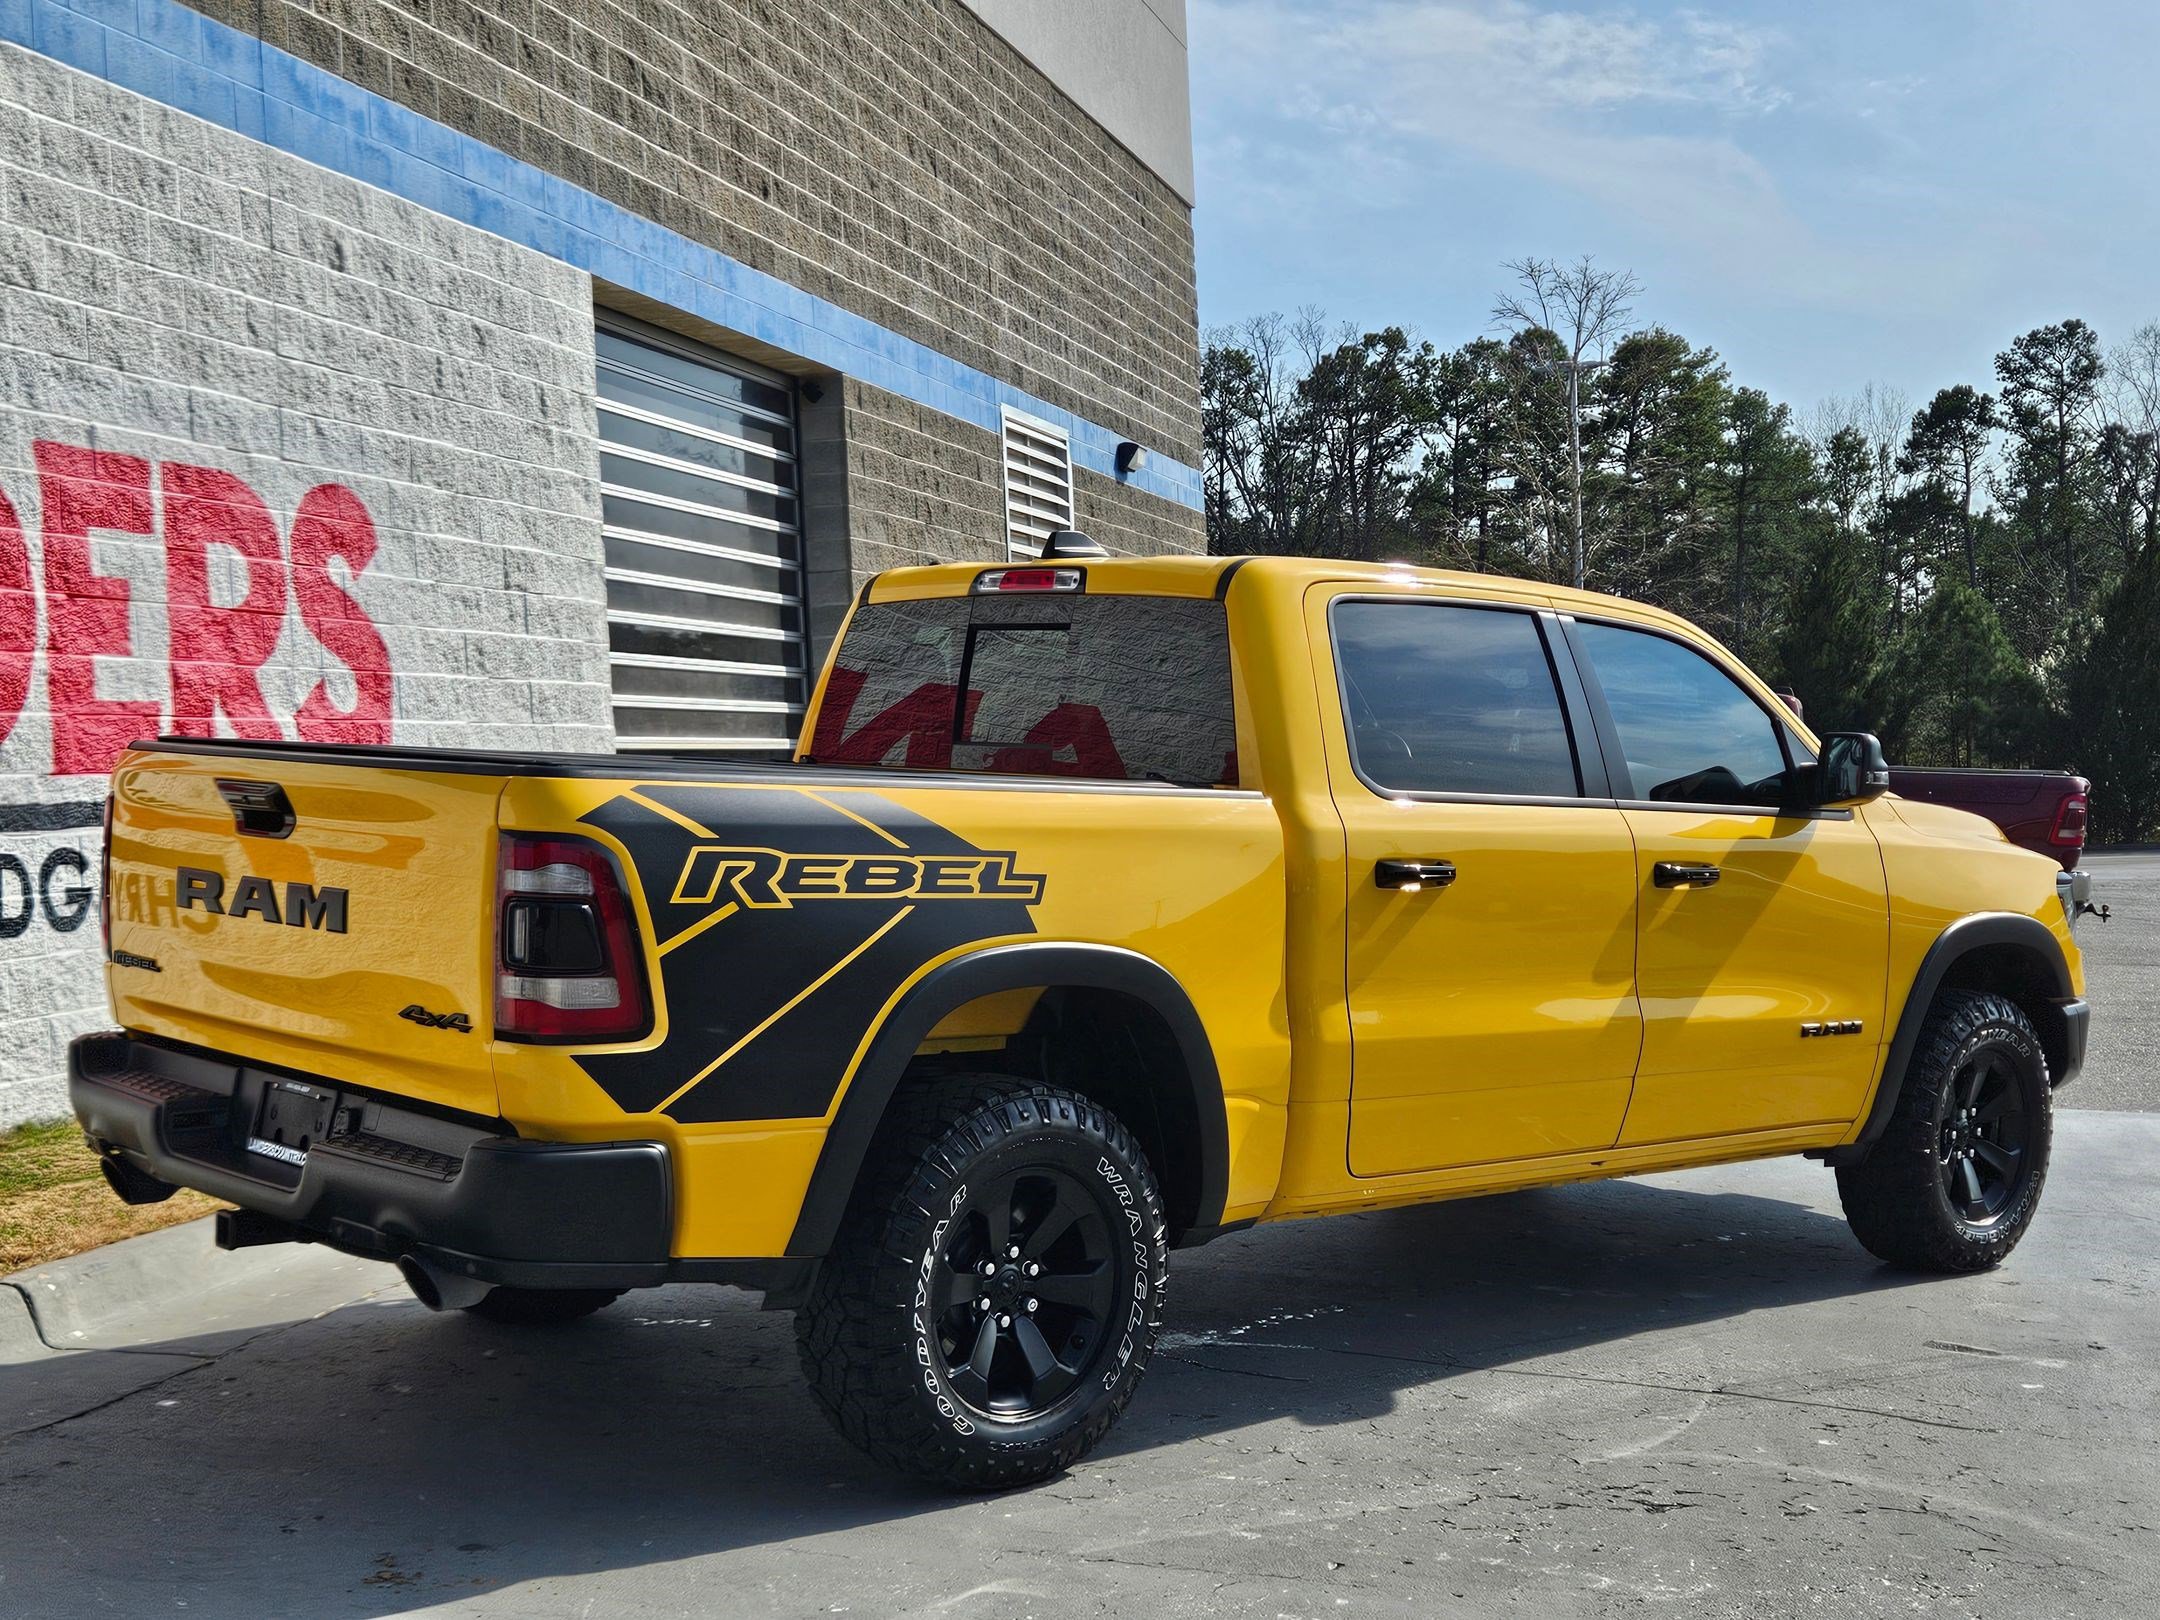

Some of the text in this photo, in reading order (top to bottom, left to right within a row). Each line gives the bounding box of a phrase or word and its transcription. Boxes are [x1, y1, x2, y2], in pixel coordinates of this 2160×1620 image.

[176, 866, 350, 934] RAM
[670, 846, 1048, 909] REBEL
[1801, 1020, 1863, 1038] RAM
[1096, 1156, 1148, 1390] WRANGLER
[913, 1184, 975, 1436] GOODYEAR
